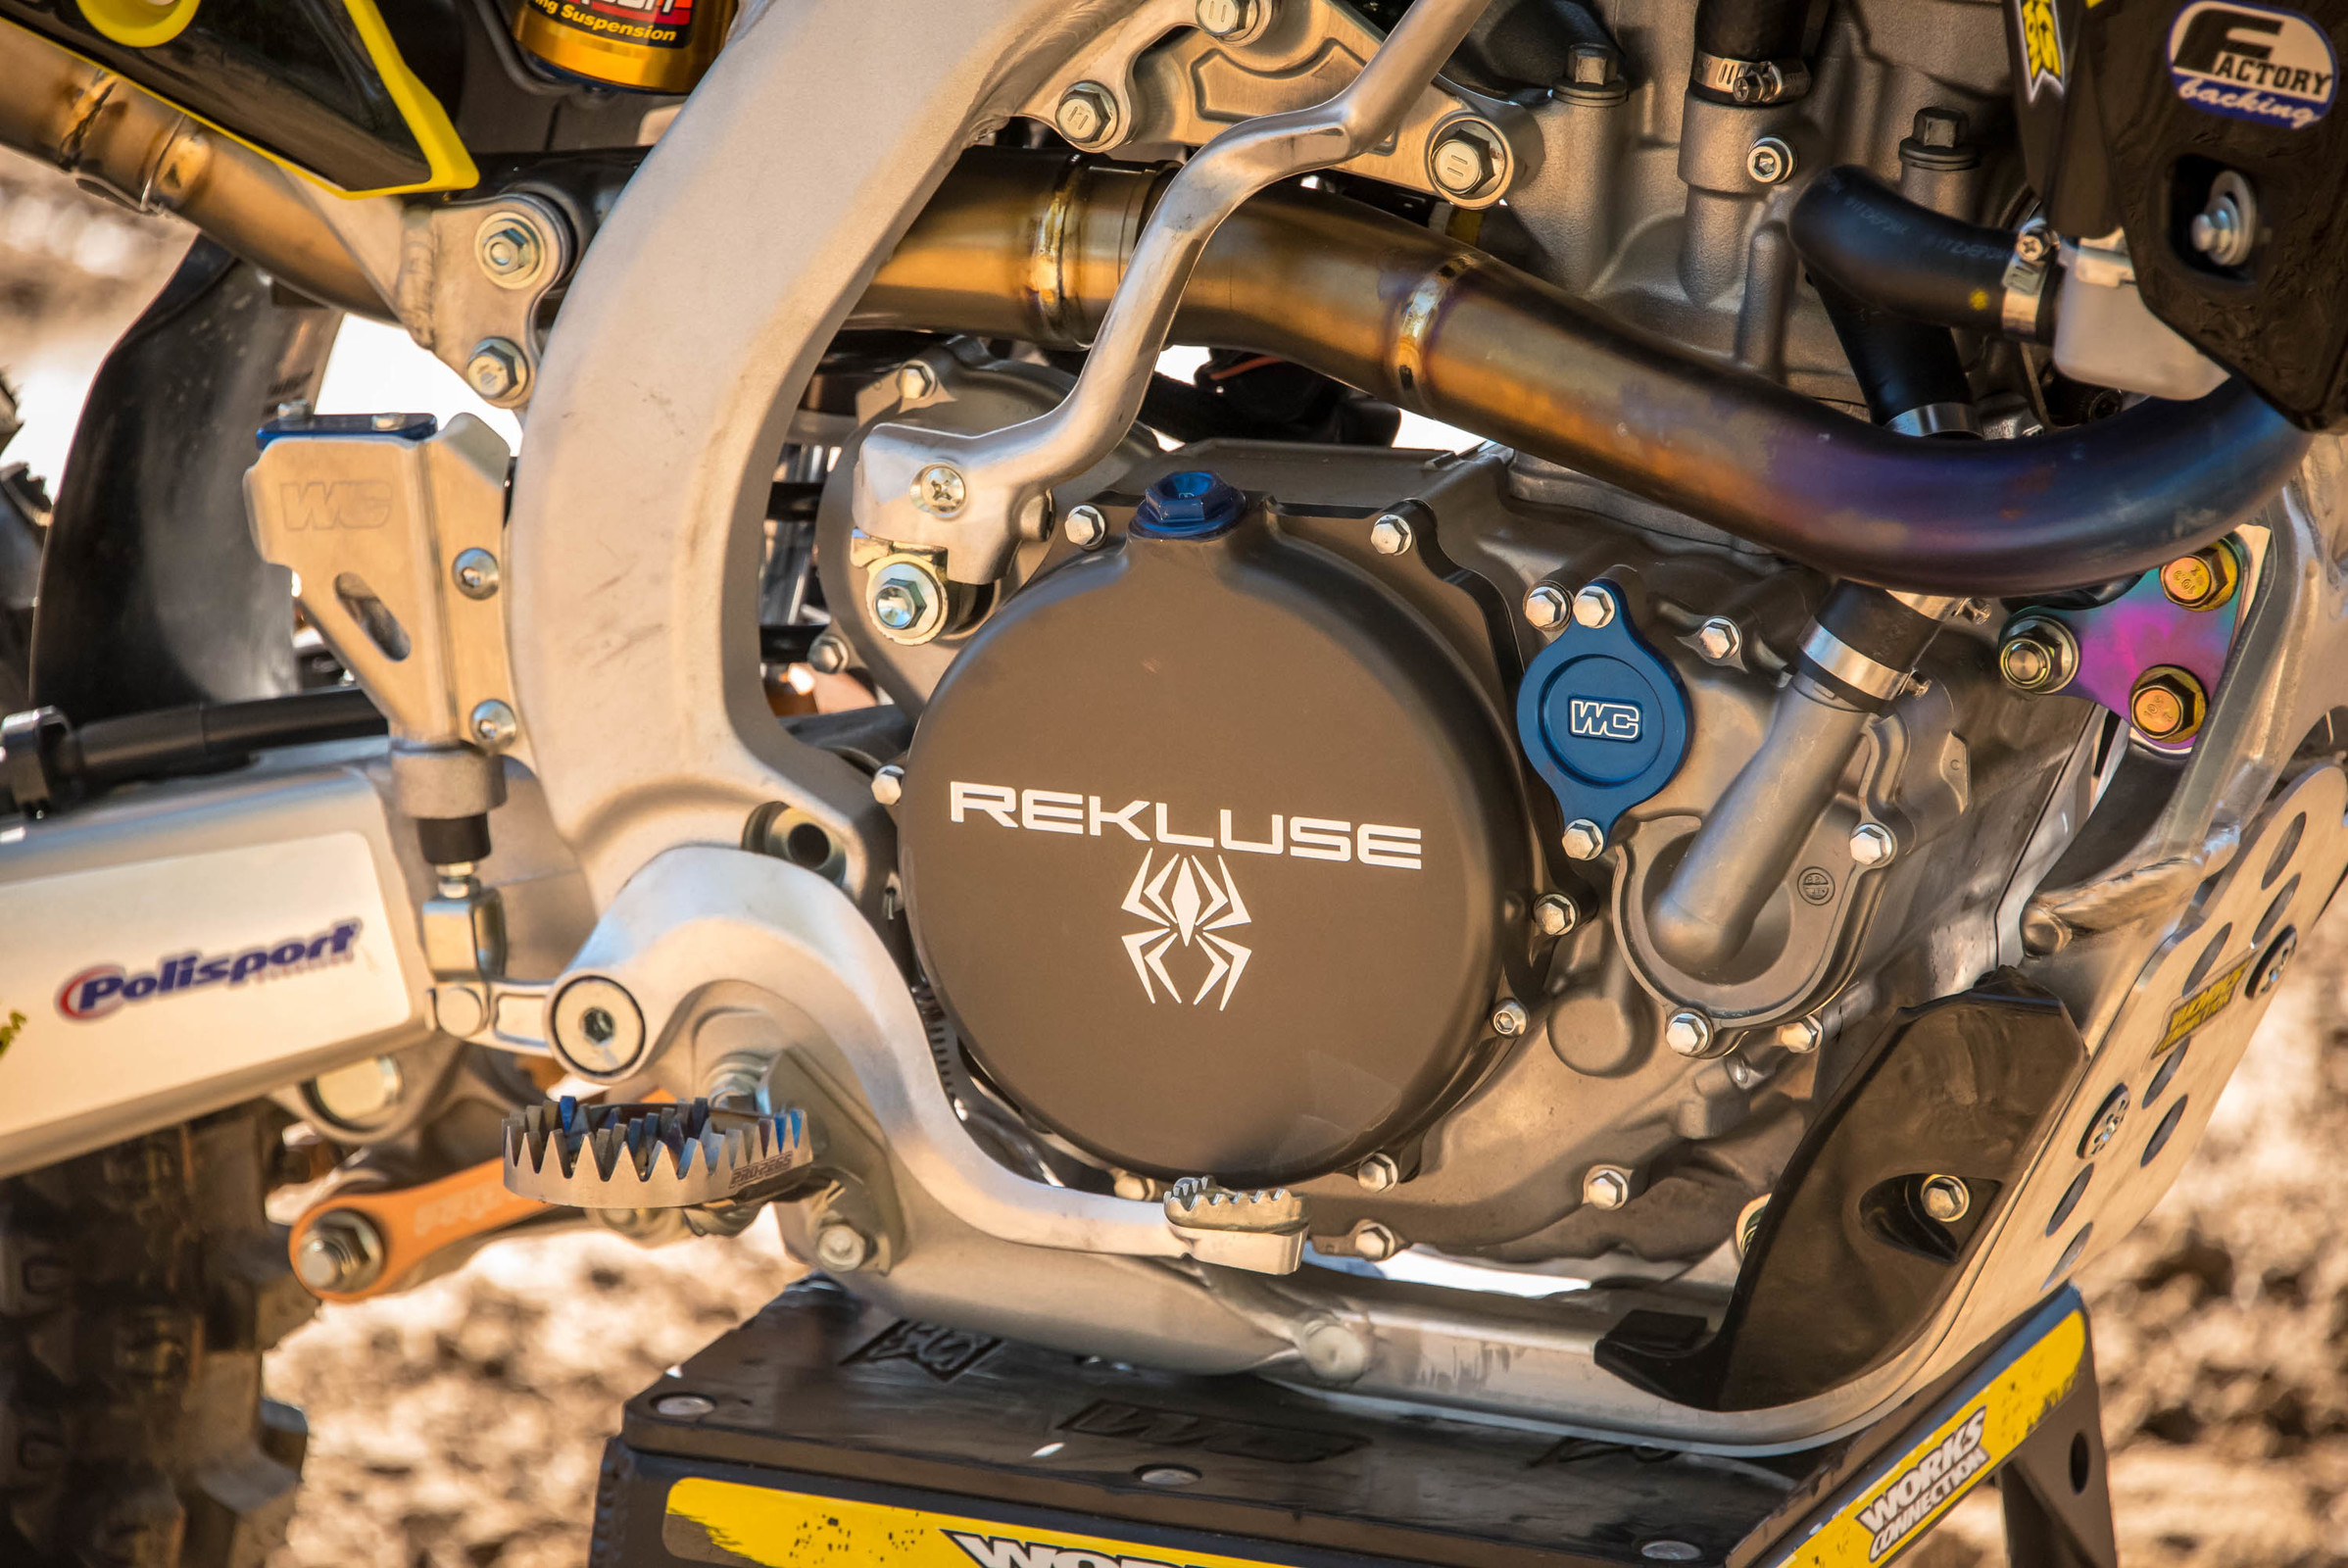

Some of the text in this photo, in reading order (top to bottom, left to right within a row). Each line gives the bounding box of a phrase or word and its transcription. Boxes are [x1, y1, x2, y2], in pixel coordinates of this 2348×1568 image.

[561, 4, 677, 41] Suspension
[2173, 9, 2333, 96] FACTORY
[2178, 77, 2322, 129] backing
[280, 481, 392, 530] WC
[1571, 700, 1639, 739] WC
[950, 780, 1422, 869] REKLUSE
[78, 922, 361, 1013] Polisport
[1858, 1406, 1986, 1532] WORKS
[1870, 1446, 1990, 1562] CONNECTION
